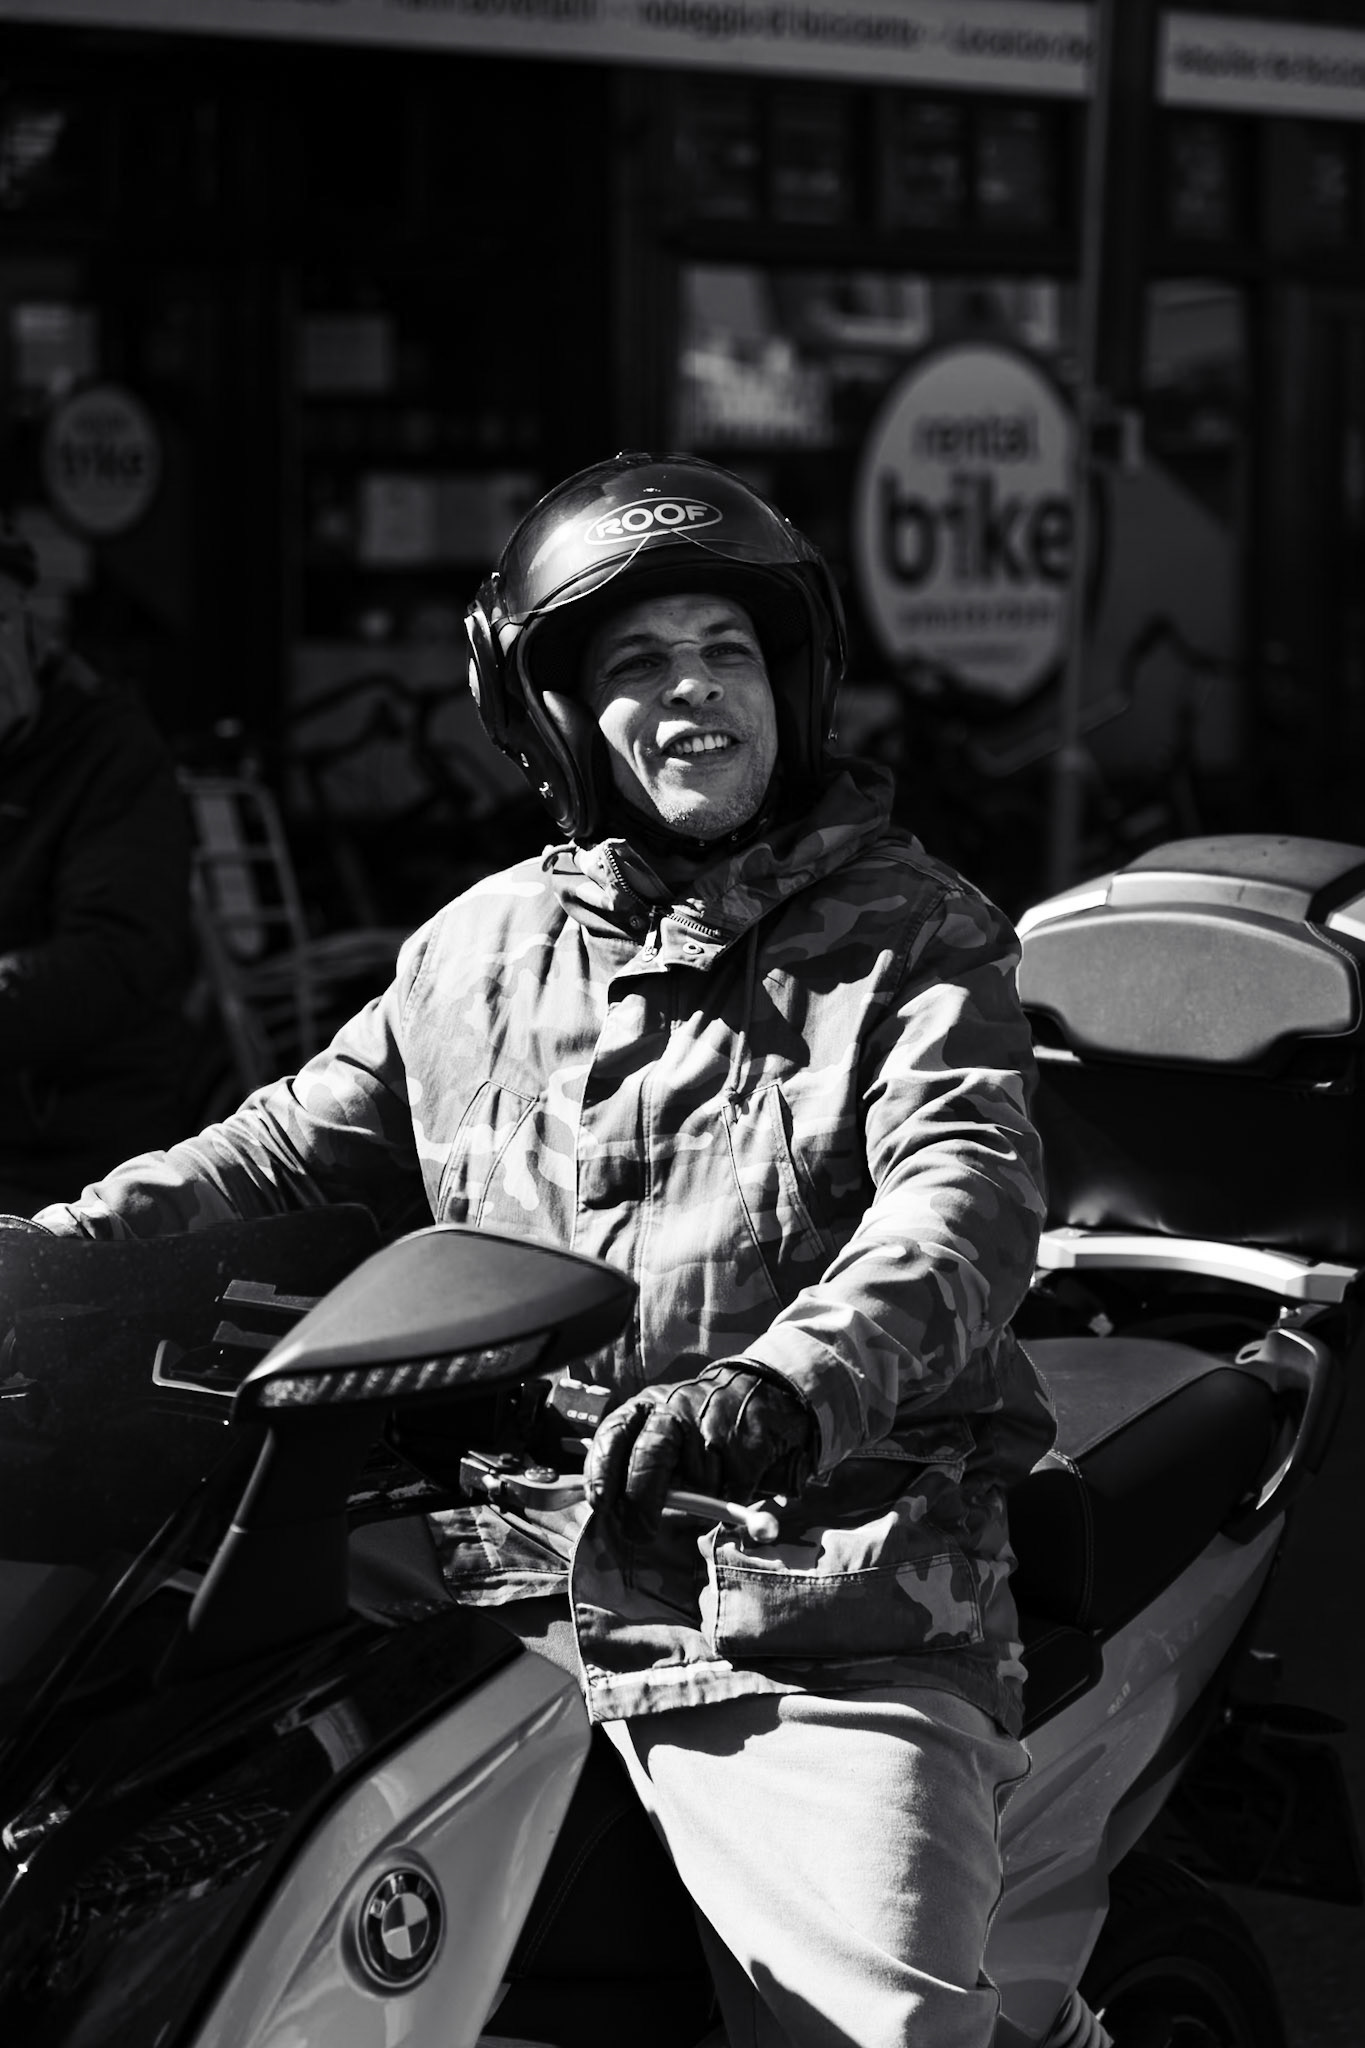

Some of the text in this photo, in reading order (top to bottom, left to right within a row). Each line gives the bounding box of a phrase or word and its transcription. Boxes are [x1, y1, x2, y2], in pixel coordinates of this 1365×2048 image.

[914, 413, 1040, 463] rental
[595, 502, 708, 538] ROOF
[878, 470, 1073, 590] bike
[369, 1874, 433, 1920] BMW
